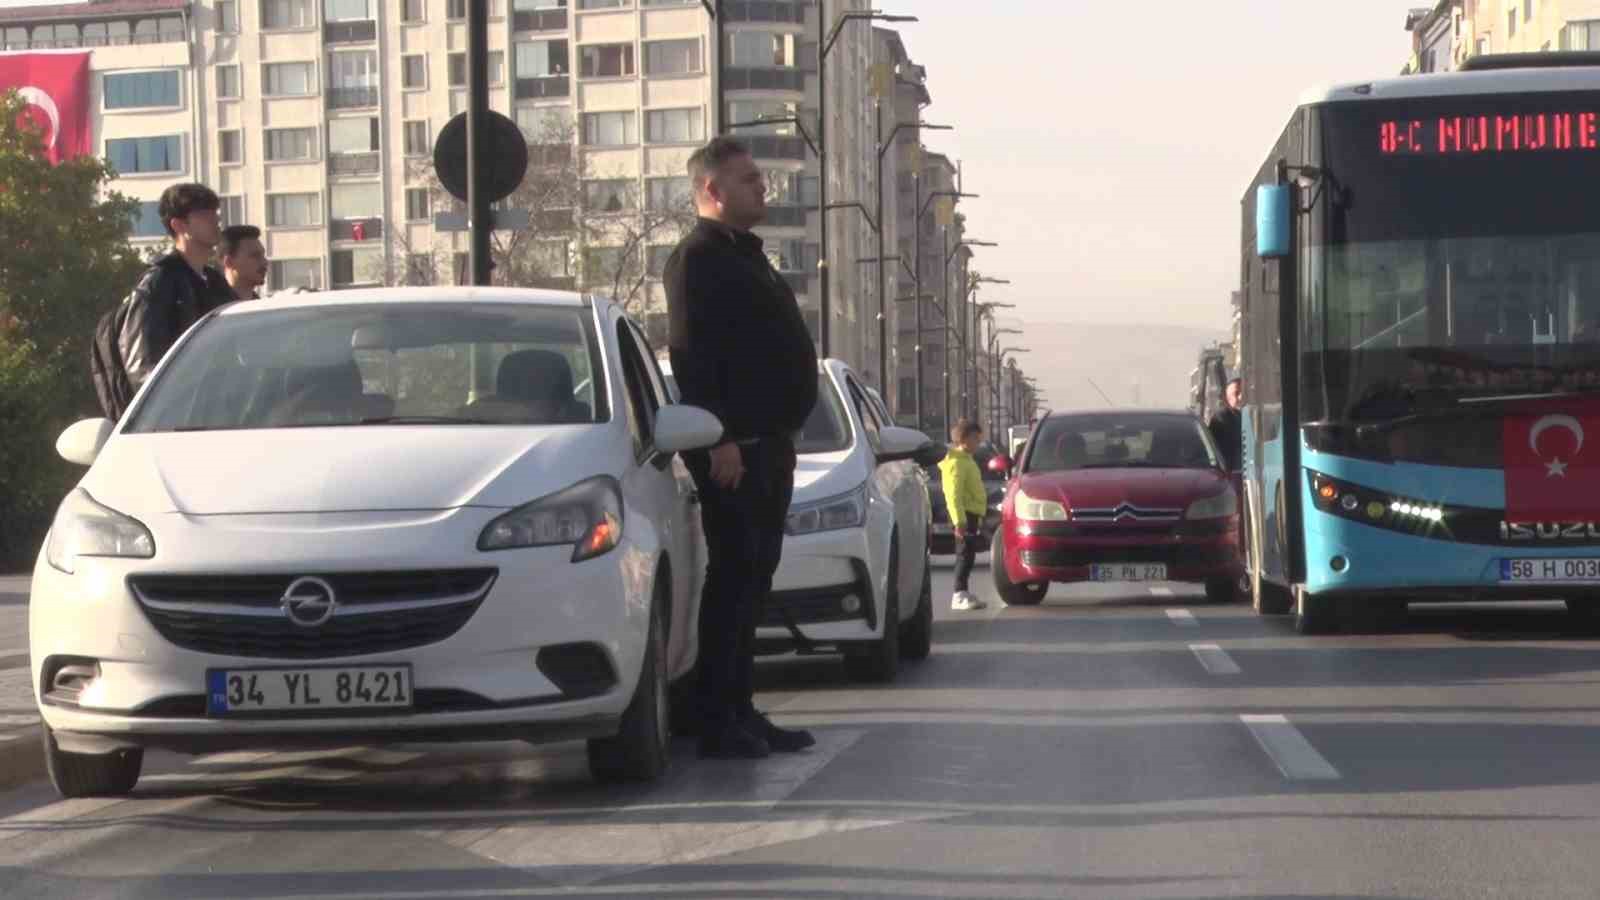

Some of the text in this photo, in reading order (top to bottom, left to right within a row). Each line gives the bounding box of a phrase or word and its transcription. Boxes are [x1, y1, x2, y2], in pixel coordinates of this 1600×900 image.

[1512, 560, 1533, 577] 58
[1543, 561, 1556, 577] H
[1565, 560, 1600, 577] 003
[228, 675, 264, 706] 34
[283, 673, 320, 705] YL
[335, 671, 406, 704] 8421
